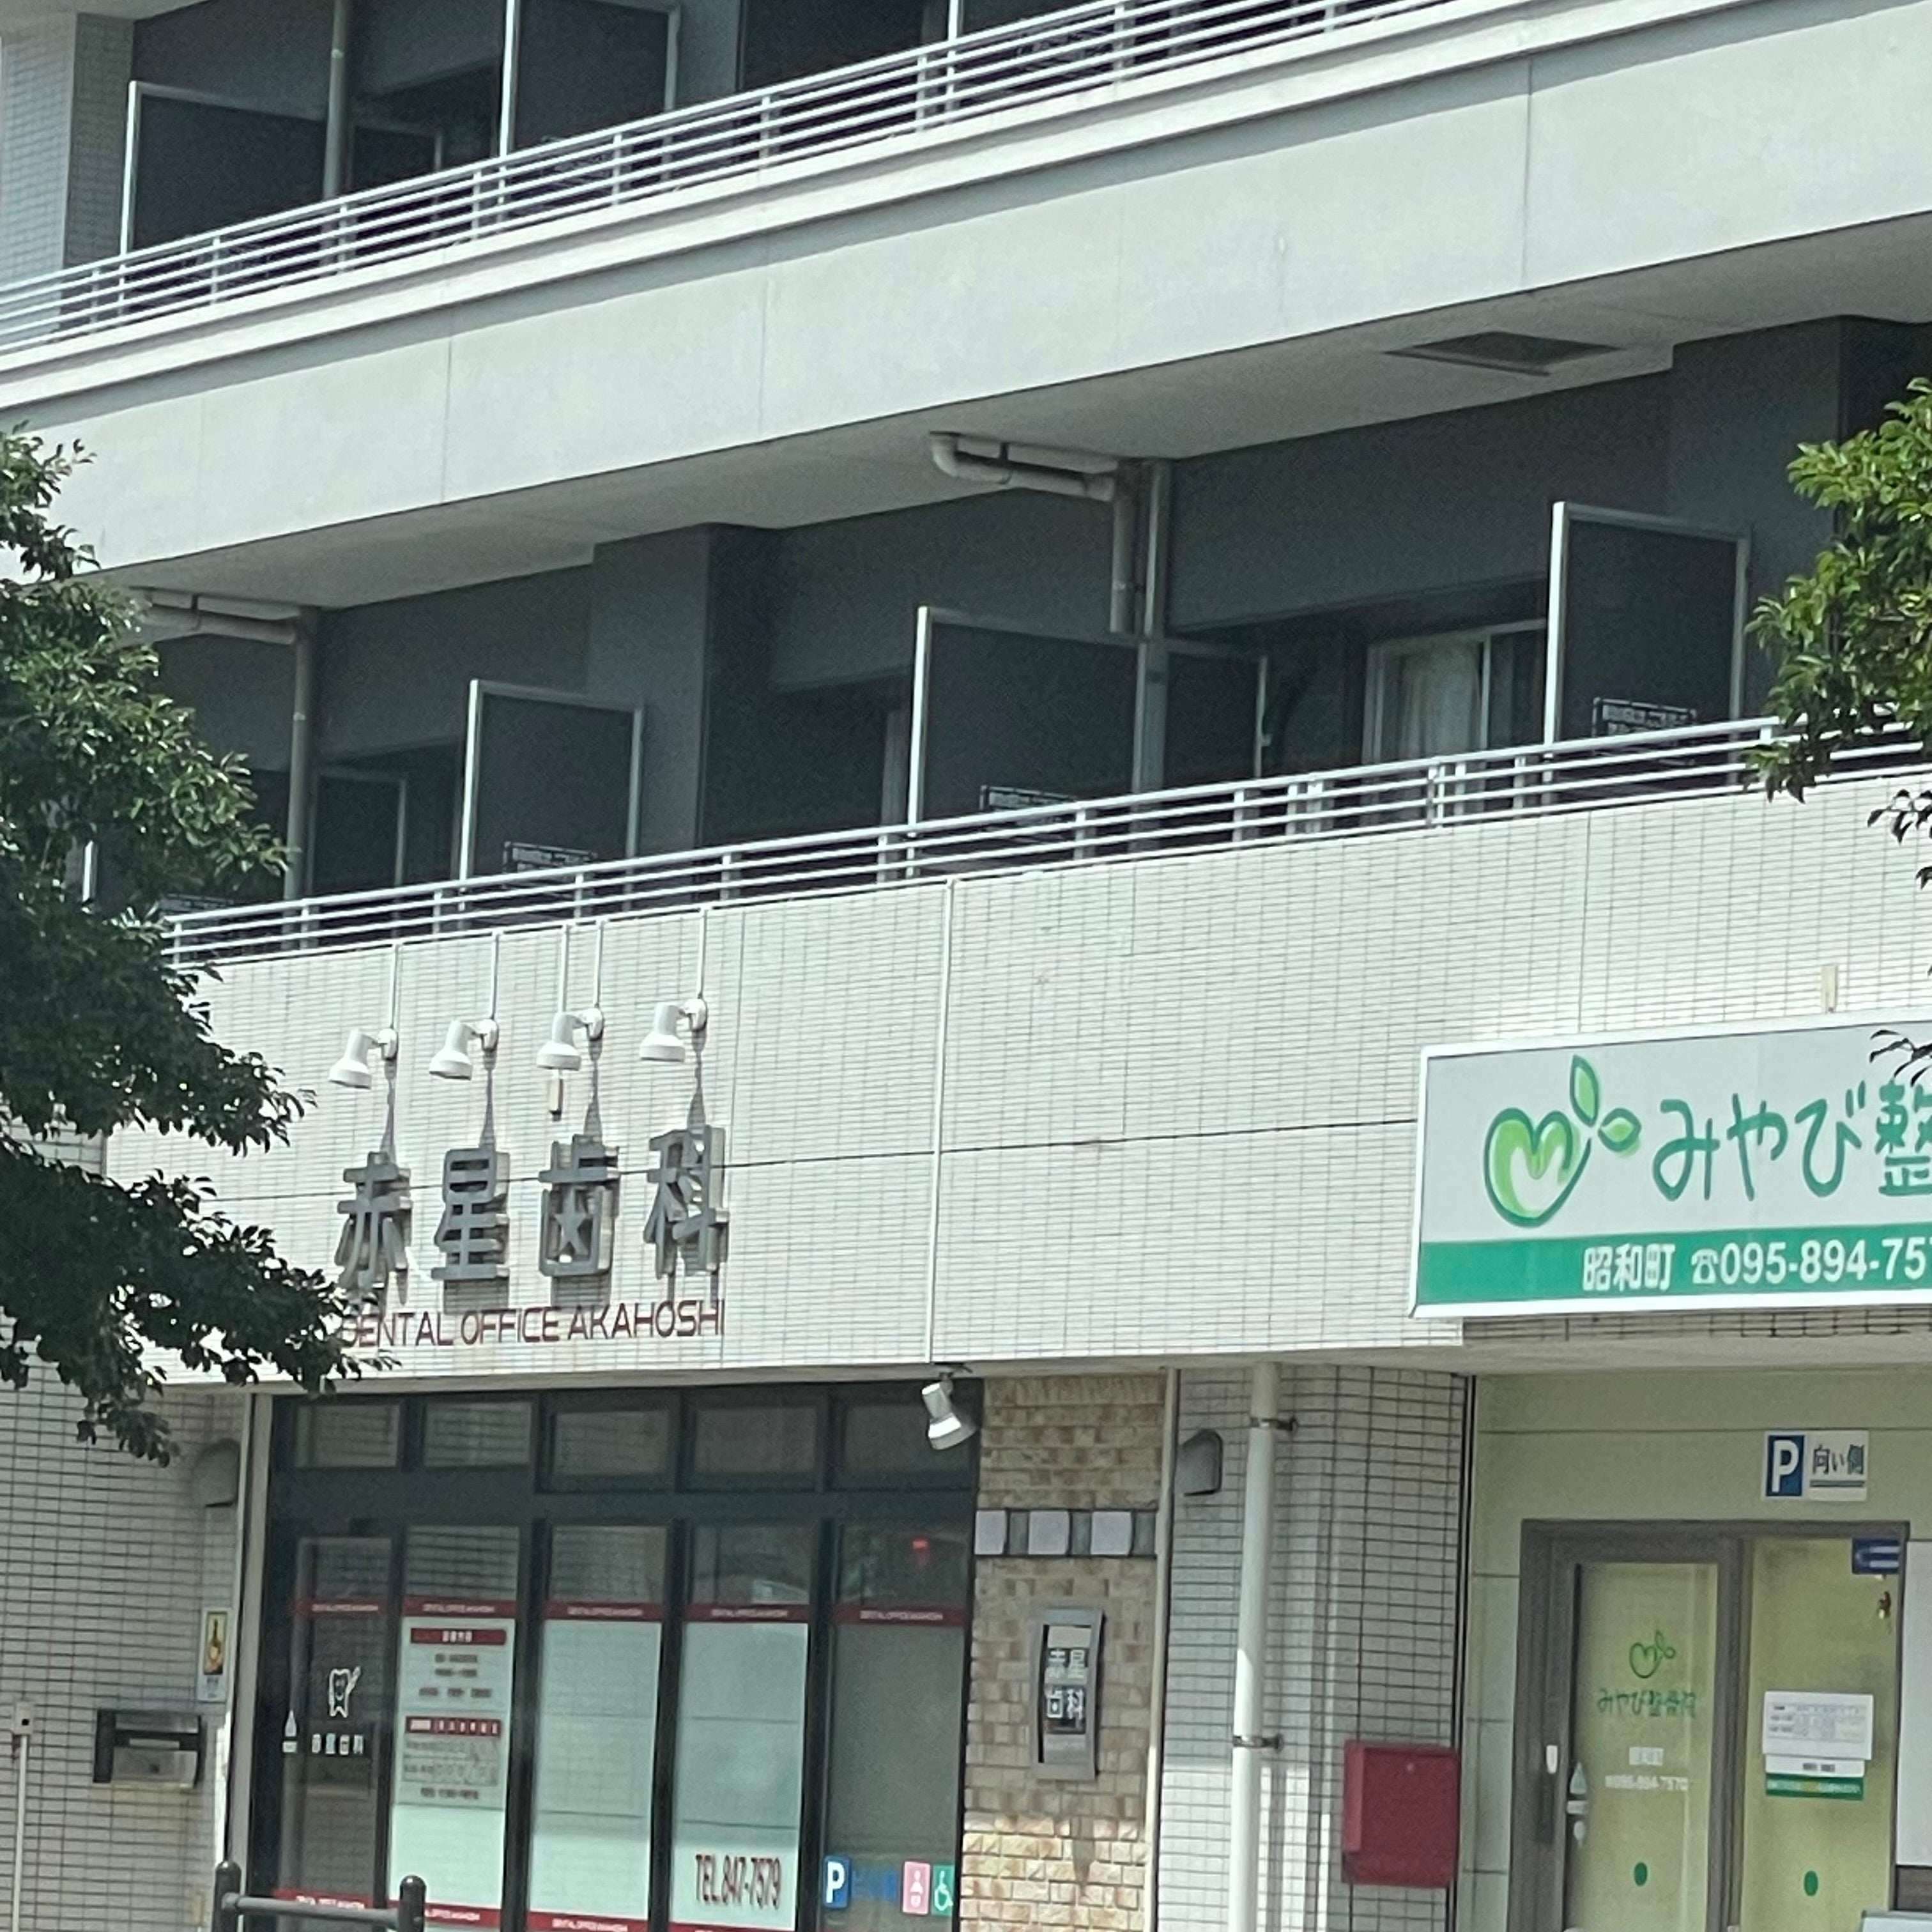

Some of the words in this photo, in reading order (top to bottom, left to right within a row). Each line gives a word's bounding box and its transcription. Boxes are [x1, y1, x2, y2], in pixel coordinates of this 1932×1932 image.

[334, 1124, 729, 1289] 赤星歯科
[1583, 1243, 1676, 1292] 昭和町
[1720, 1236, 1932, 1285] 095-894-75
[341, 1310, 454, 1347] DENTAL
[461, 1305, 560, 1344] OFFICE
[567, 1298, 726, 1341] AKAHOSHI
[1771, 1439, 1799, 1493] P
[825, 1861, 845, 1903] P
